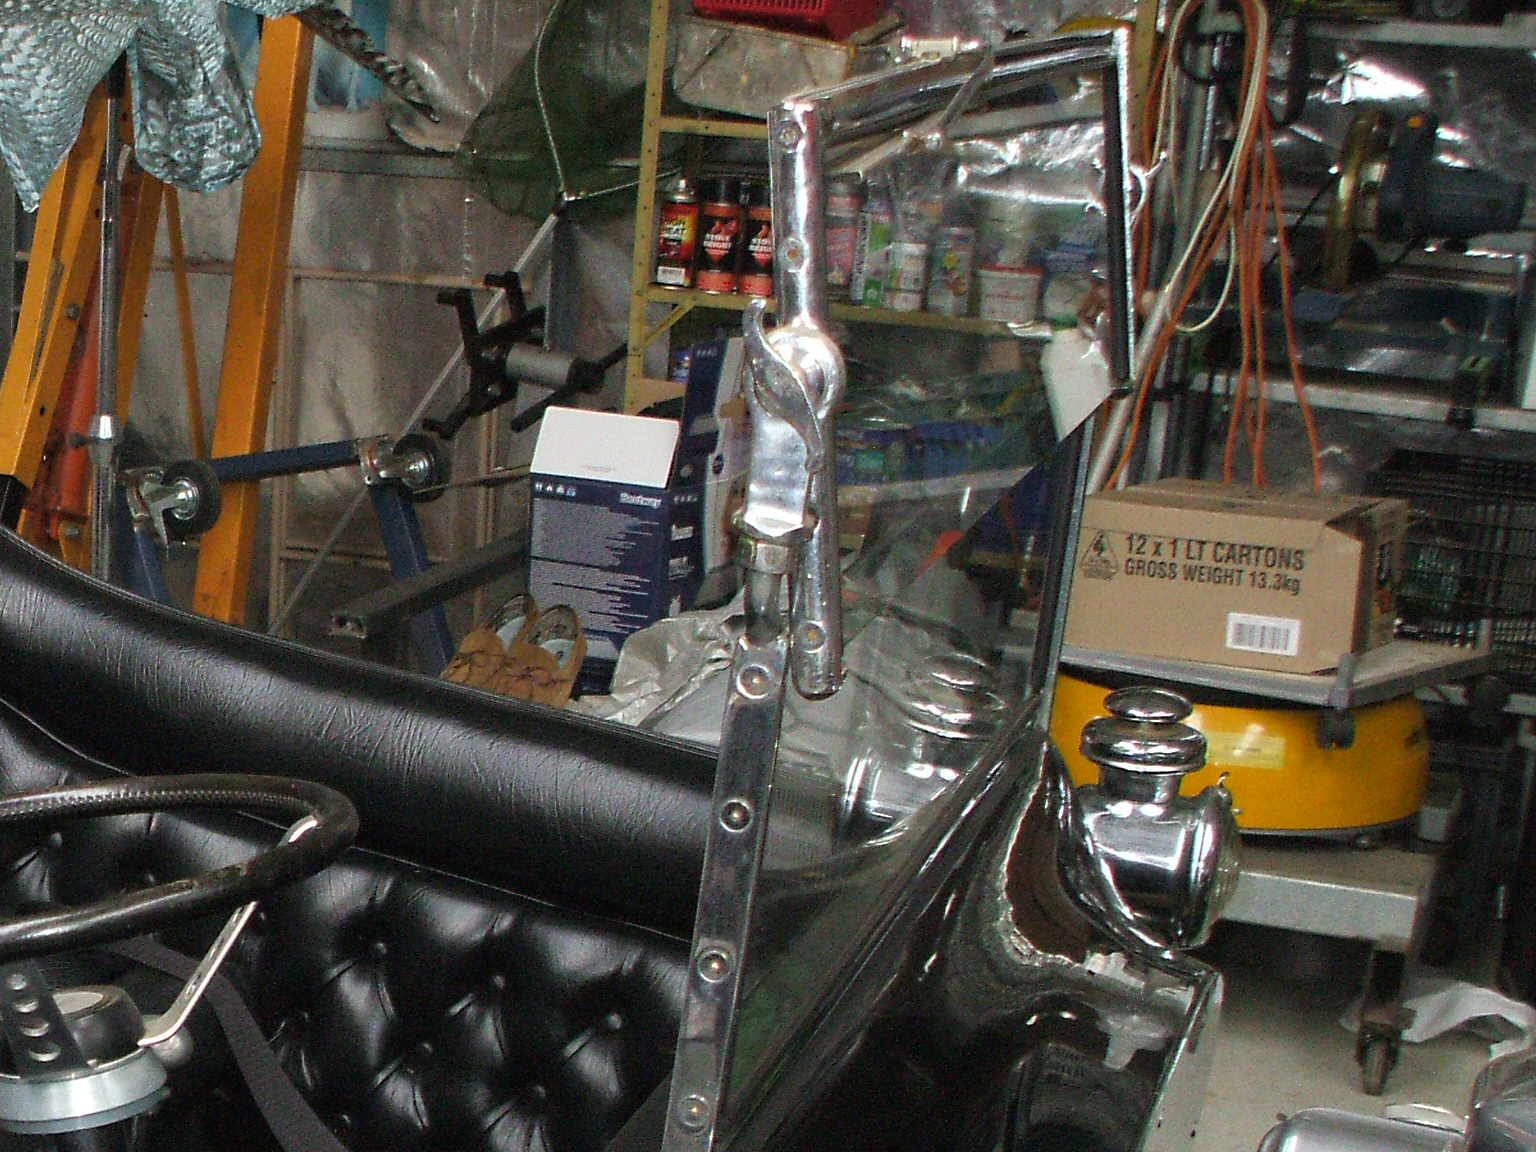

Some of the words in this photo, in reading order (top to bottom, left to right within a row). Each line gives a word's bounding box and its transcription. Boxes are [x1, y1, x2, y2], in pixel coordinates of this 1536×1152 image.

[1125, 532, 1148, 555] 12
[1151, 542, 1162, 557] x
[1169, 537, 1178, 559] 1
[1186, 538, 1207, 562] LT
[1213, 541, 1305, 571] CARTONS
[1124, 557, 1178, 580] GROSS
[1183, 563, 1244, 587] WEIGHT
[1248, 570, 1301, 596] 13.3kg
